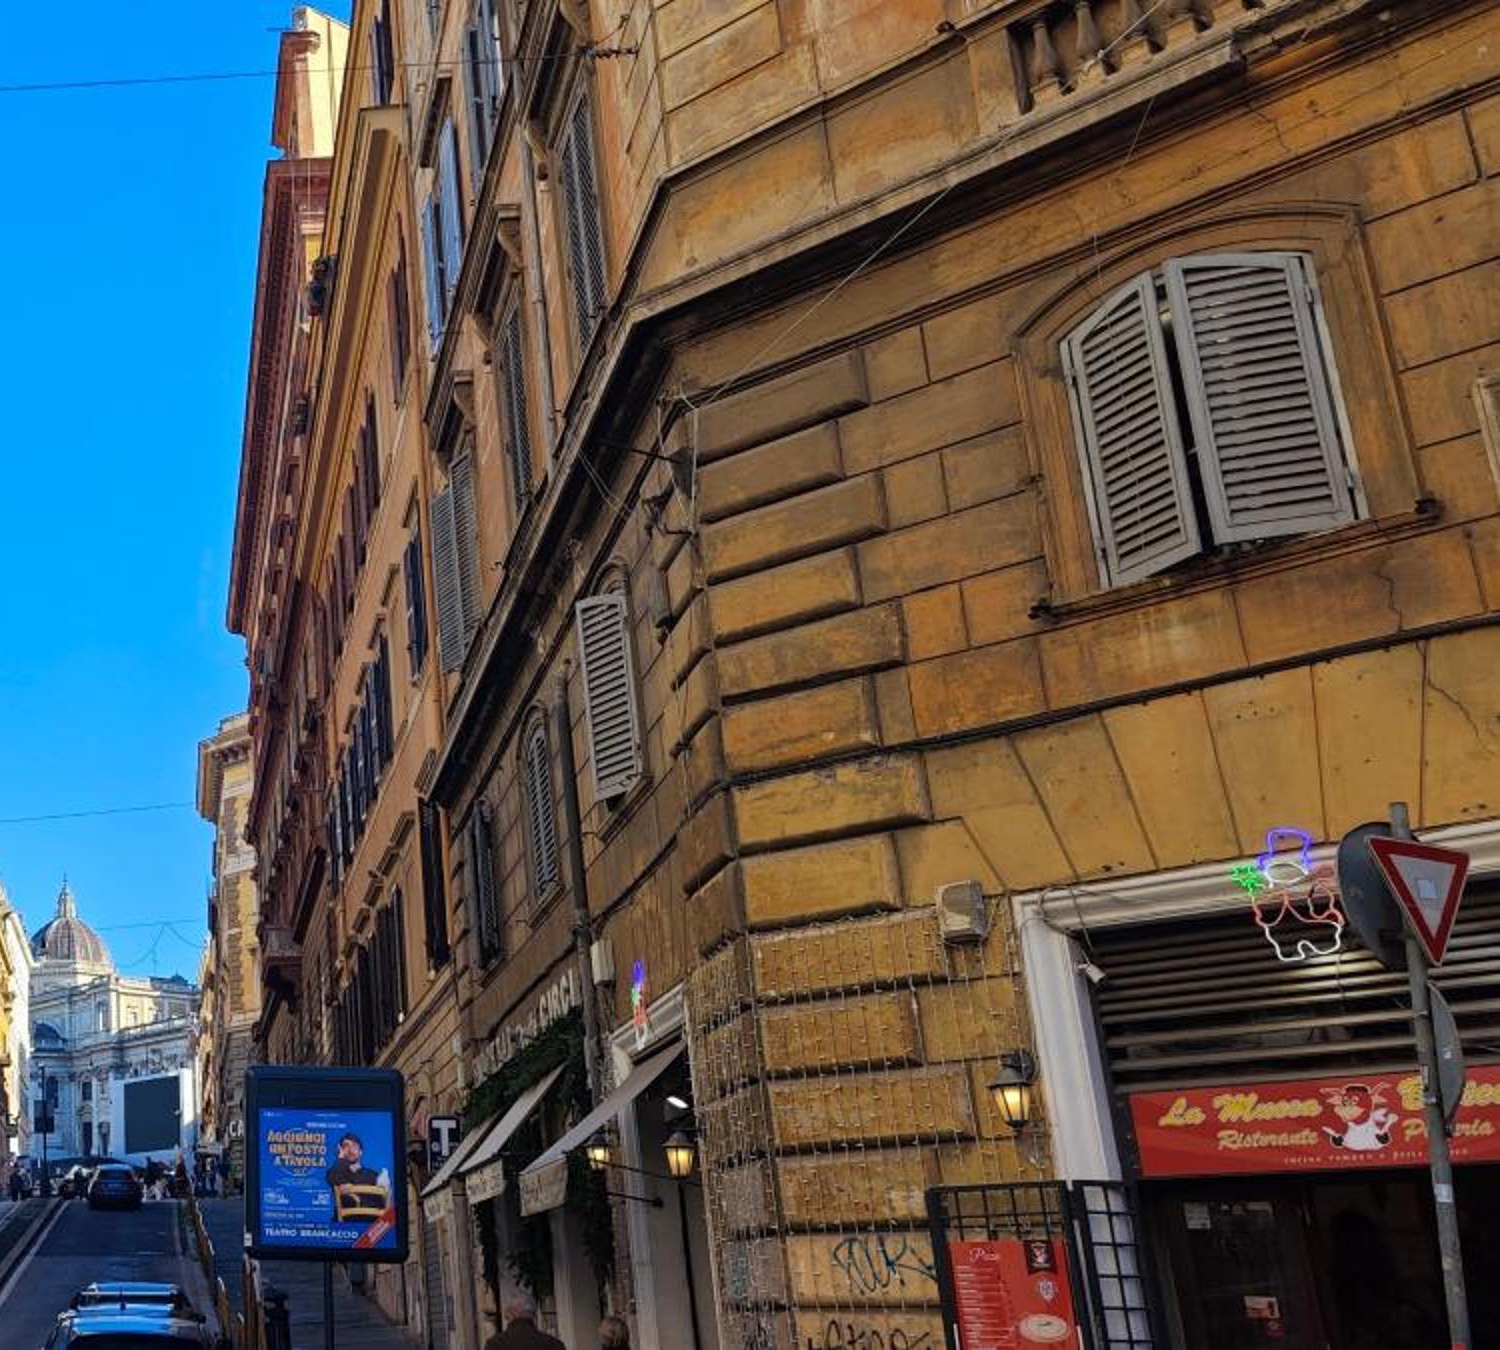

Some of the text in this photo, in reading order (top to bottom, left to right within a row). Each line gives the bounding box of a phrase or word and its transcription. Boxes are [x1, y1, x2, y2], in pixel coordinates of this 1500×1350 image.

[1157, 1096, 1206, 1126] La
[432, 1120, 457, 1156] T
[1217, 1128, 1317, 1150] Ristorante
[288, 1143, 327, 1156] POSTO
[282, 1155, 327, 1167] TAVOLA
[264, 1228, 359, 1239] TEATRO BRANCACCIO
